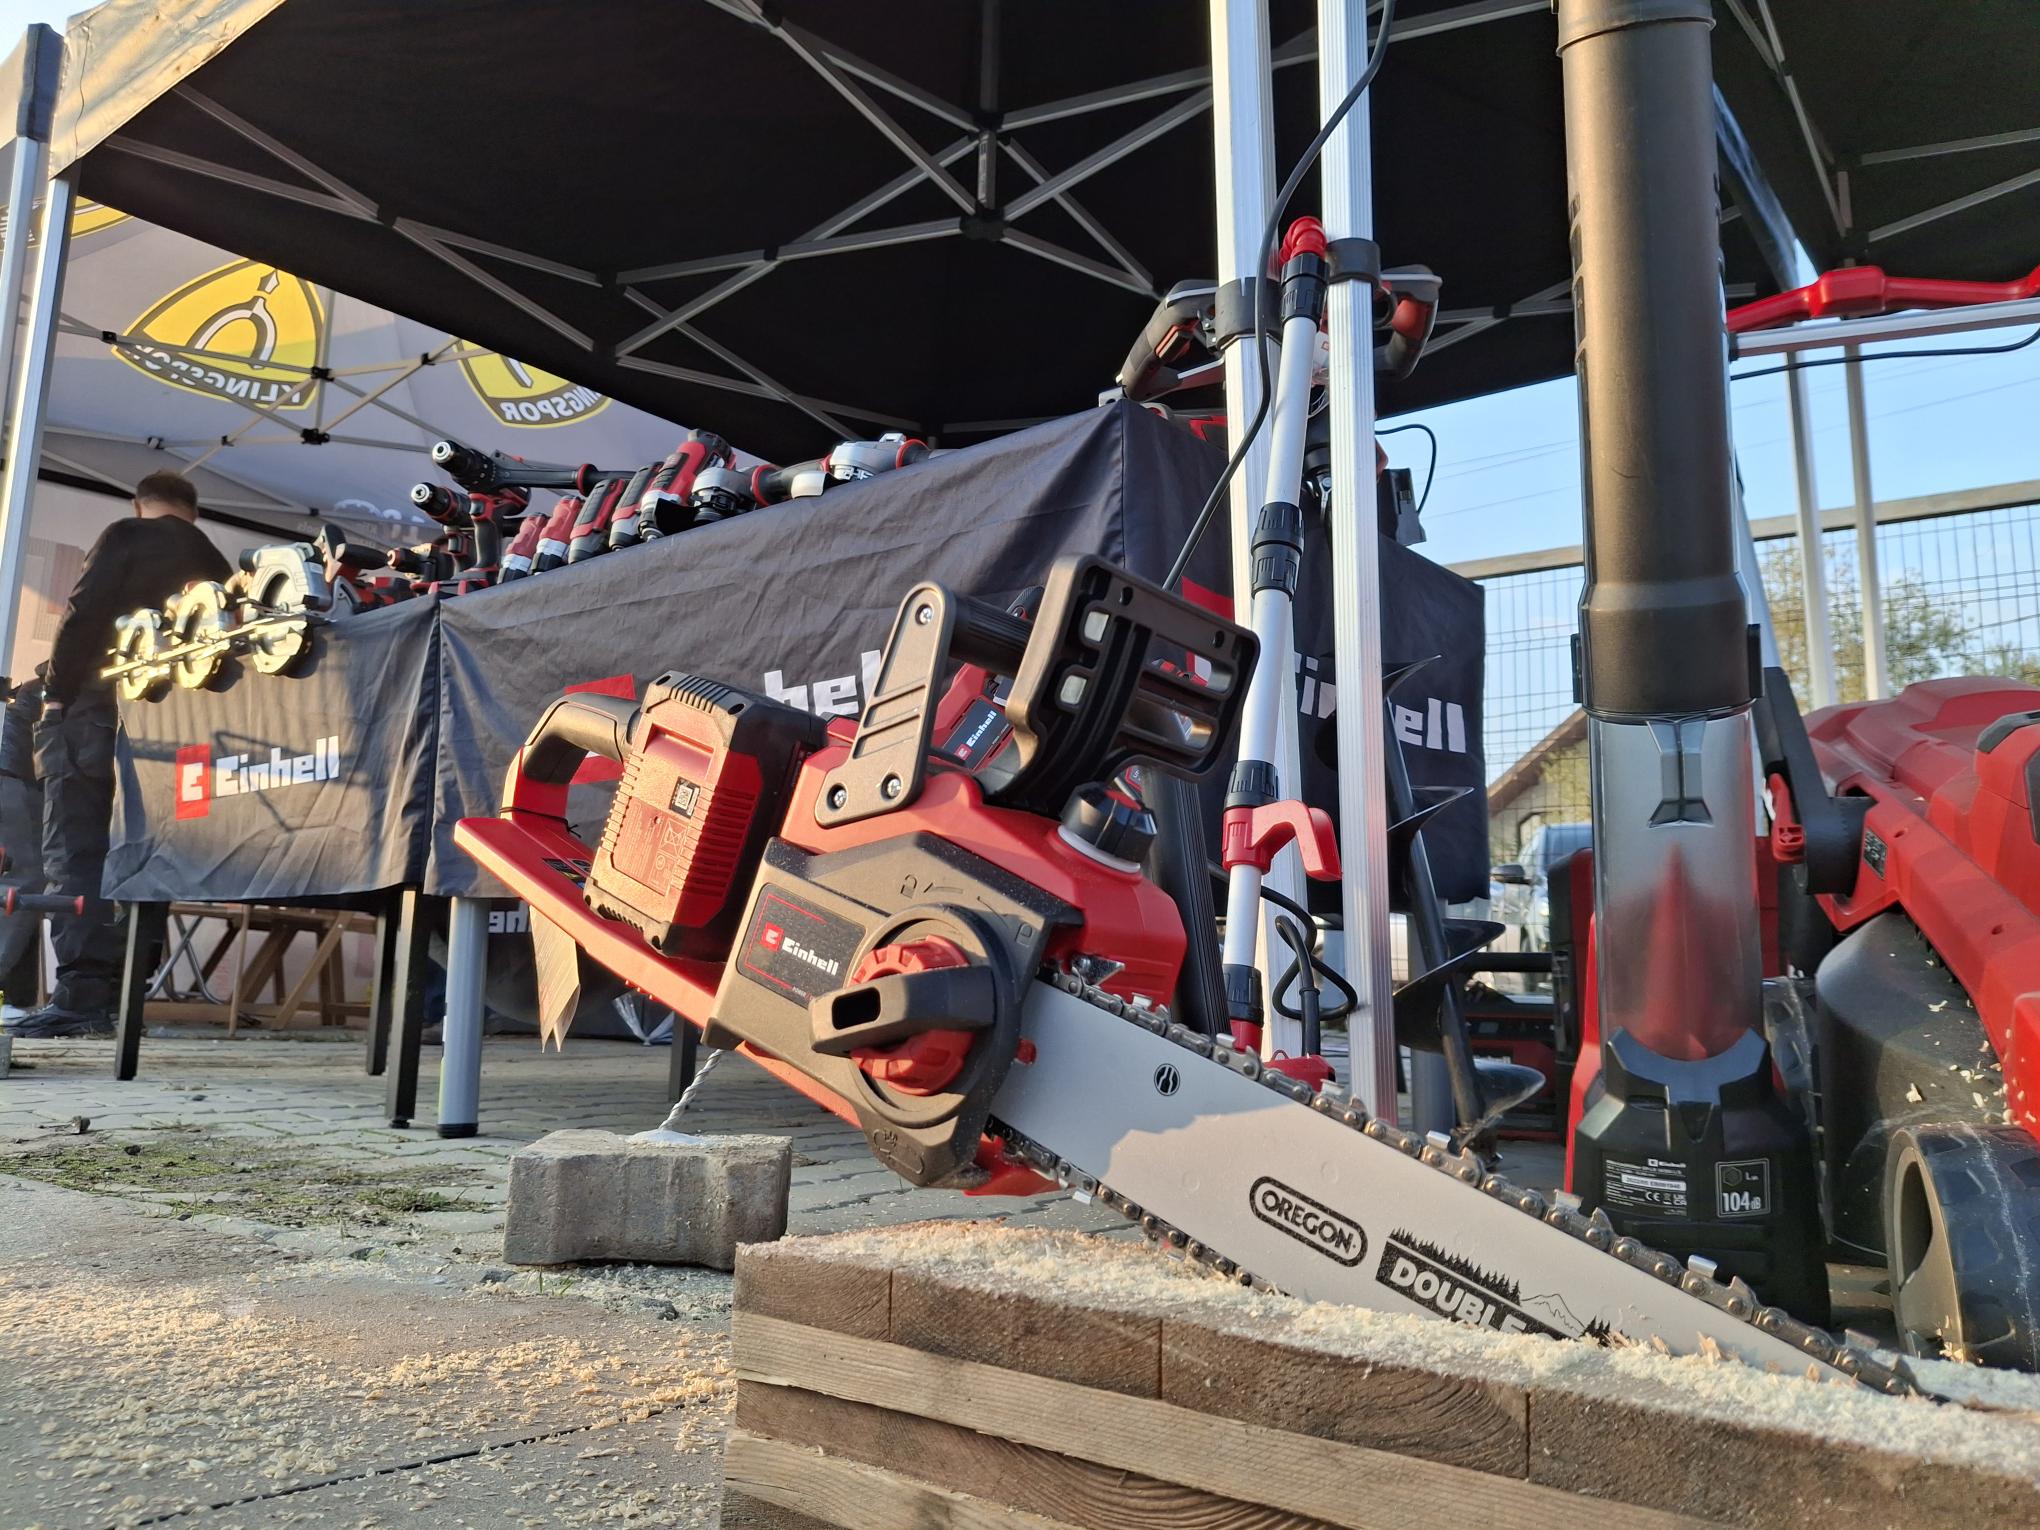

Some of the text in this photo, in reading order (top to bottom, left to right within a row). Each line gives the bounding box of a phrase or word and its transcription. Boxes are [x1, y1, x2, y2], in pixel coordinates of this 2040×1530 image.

[966, 710, 997, 747] Einhell
[1294, 650, 1466, 754] inell
[215, 735, 340, 798] Einhell
[781, 936, 839, 976] Einhell
[1261, 1189, 1354, 1254] OREGON
